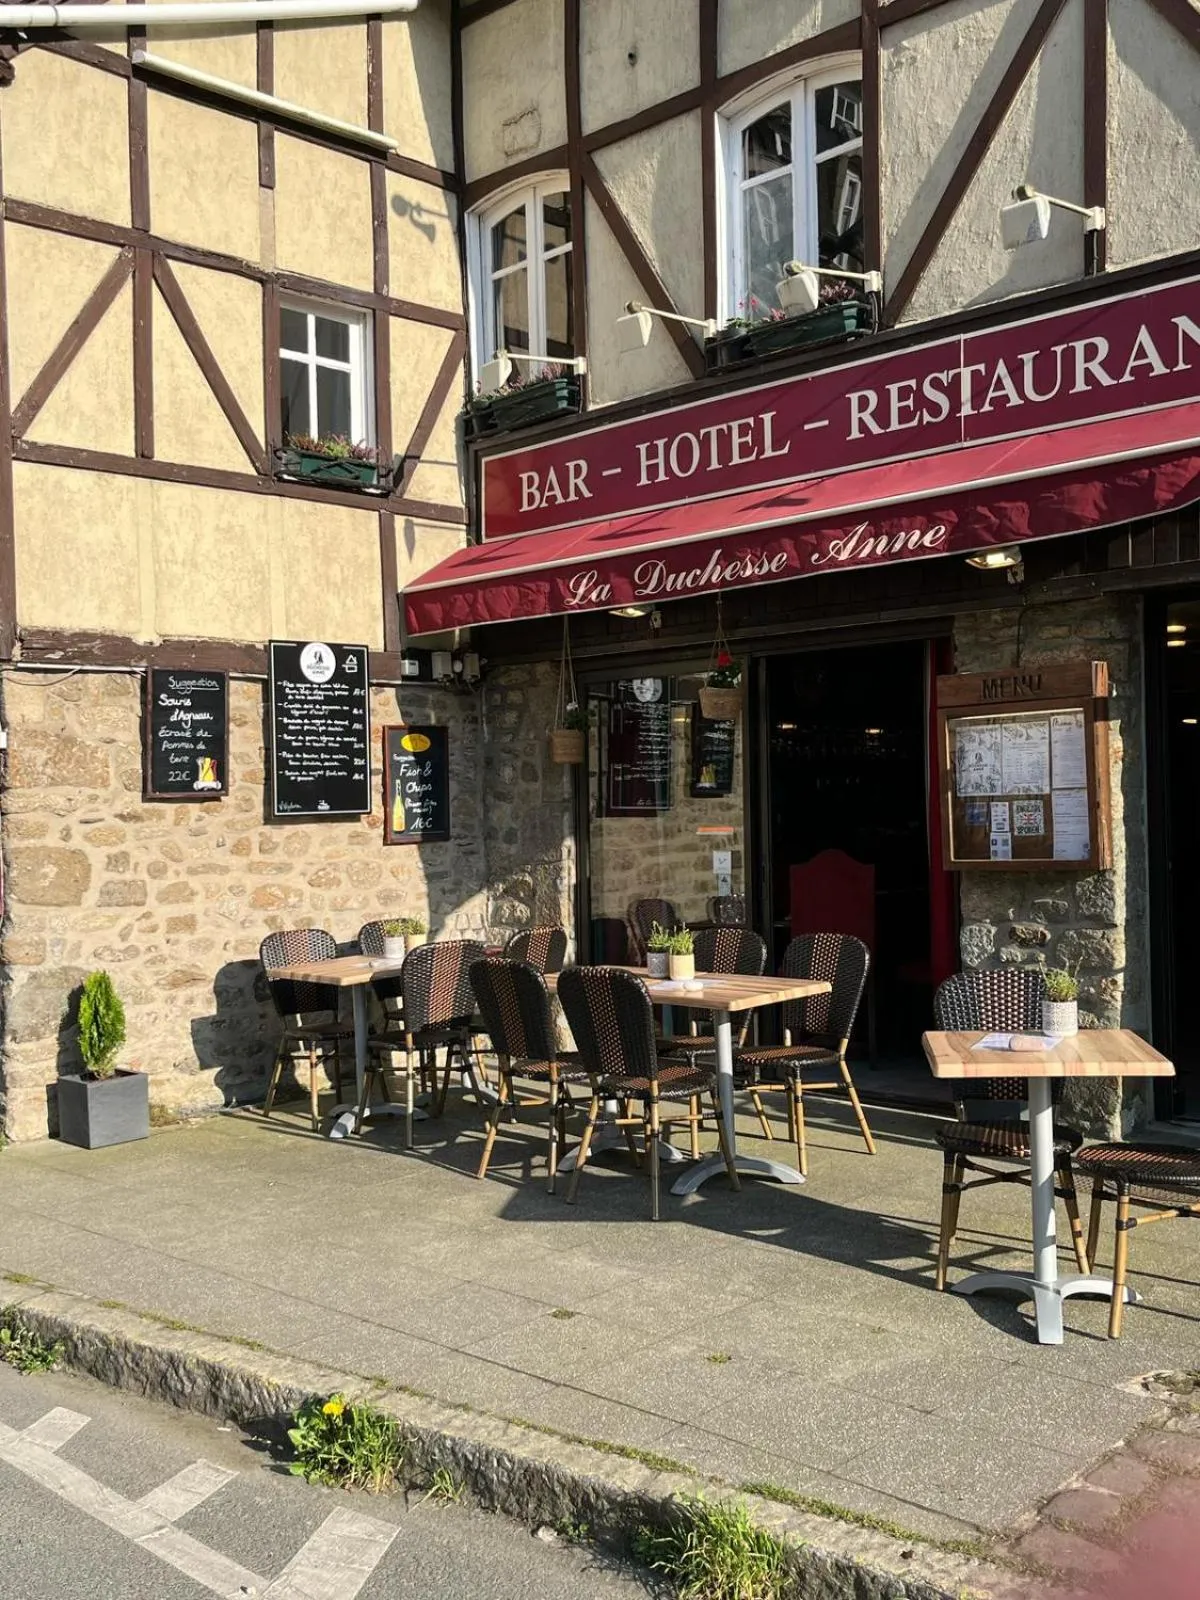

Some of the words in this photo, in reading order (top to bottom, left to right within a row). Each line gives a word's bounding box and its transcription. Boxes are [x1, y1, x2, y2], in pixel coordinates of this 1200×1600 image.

[519, 459, 593, 513] BAR
[635, 410, 791, 488] HOTEL
[564, 569, 612, 605] La
[634, 548, 788, 597] Duchesse
[812, 520, 947, 566] Anne
[168, 675, 220, 694] Suggestion
[981, 673, 1043, 699] MENU
[158, 693, 192, 706] Souris
[399, 763, 422, 778] Fish
[423, 760, 433, 777] &
[405, 781, 433, 797] Chips
